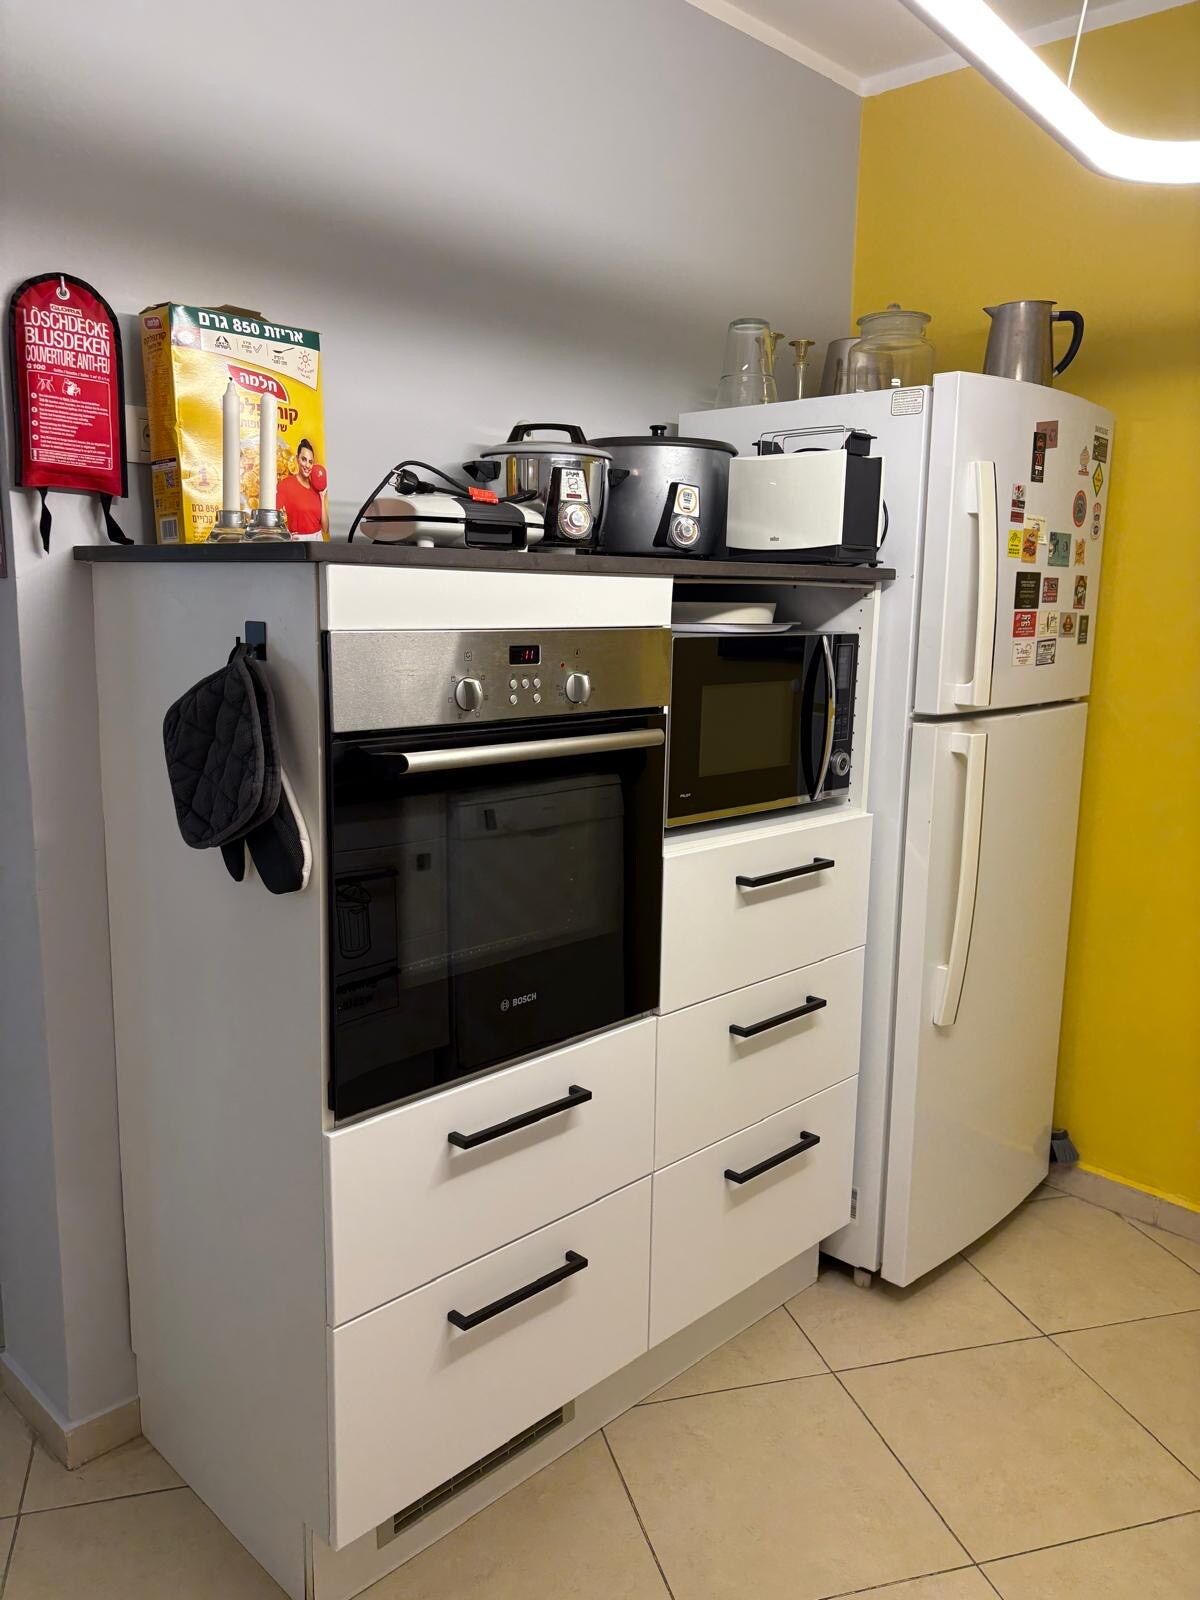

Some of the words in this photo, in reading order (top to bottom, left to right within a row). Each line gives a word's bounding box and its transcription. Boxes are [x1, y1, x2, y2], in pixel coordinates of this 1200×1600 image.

[24, 306, 109, 339] LÖSCHDECKE
[198, 311, 229, 330] גרם
[232, 318, 260, 335] 850
[24, 326, 110, 357] BLUSDEKEN
[263, 325, 304, 343] אריזת
[25, 344, 77, 368] COUVERTURE
[77, 352, 110, 374] ANTI-FEU
[512, 992, 537, 1007] BOSCH
